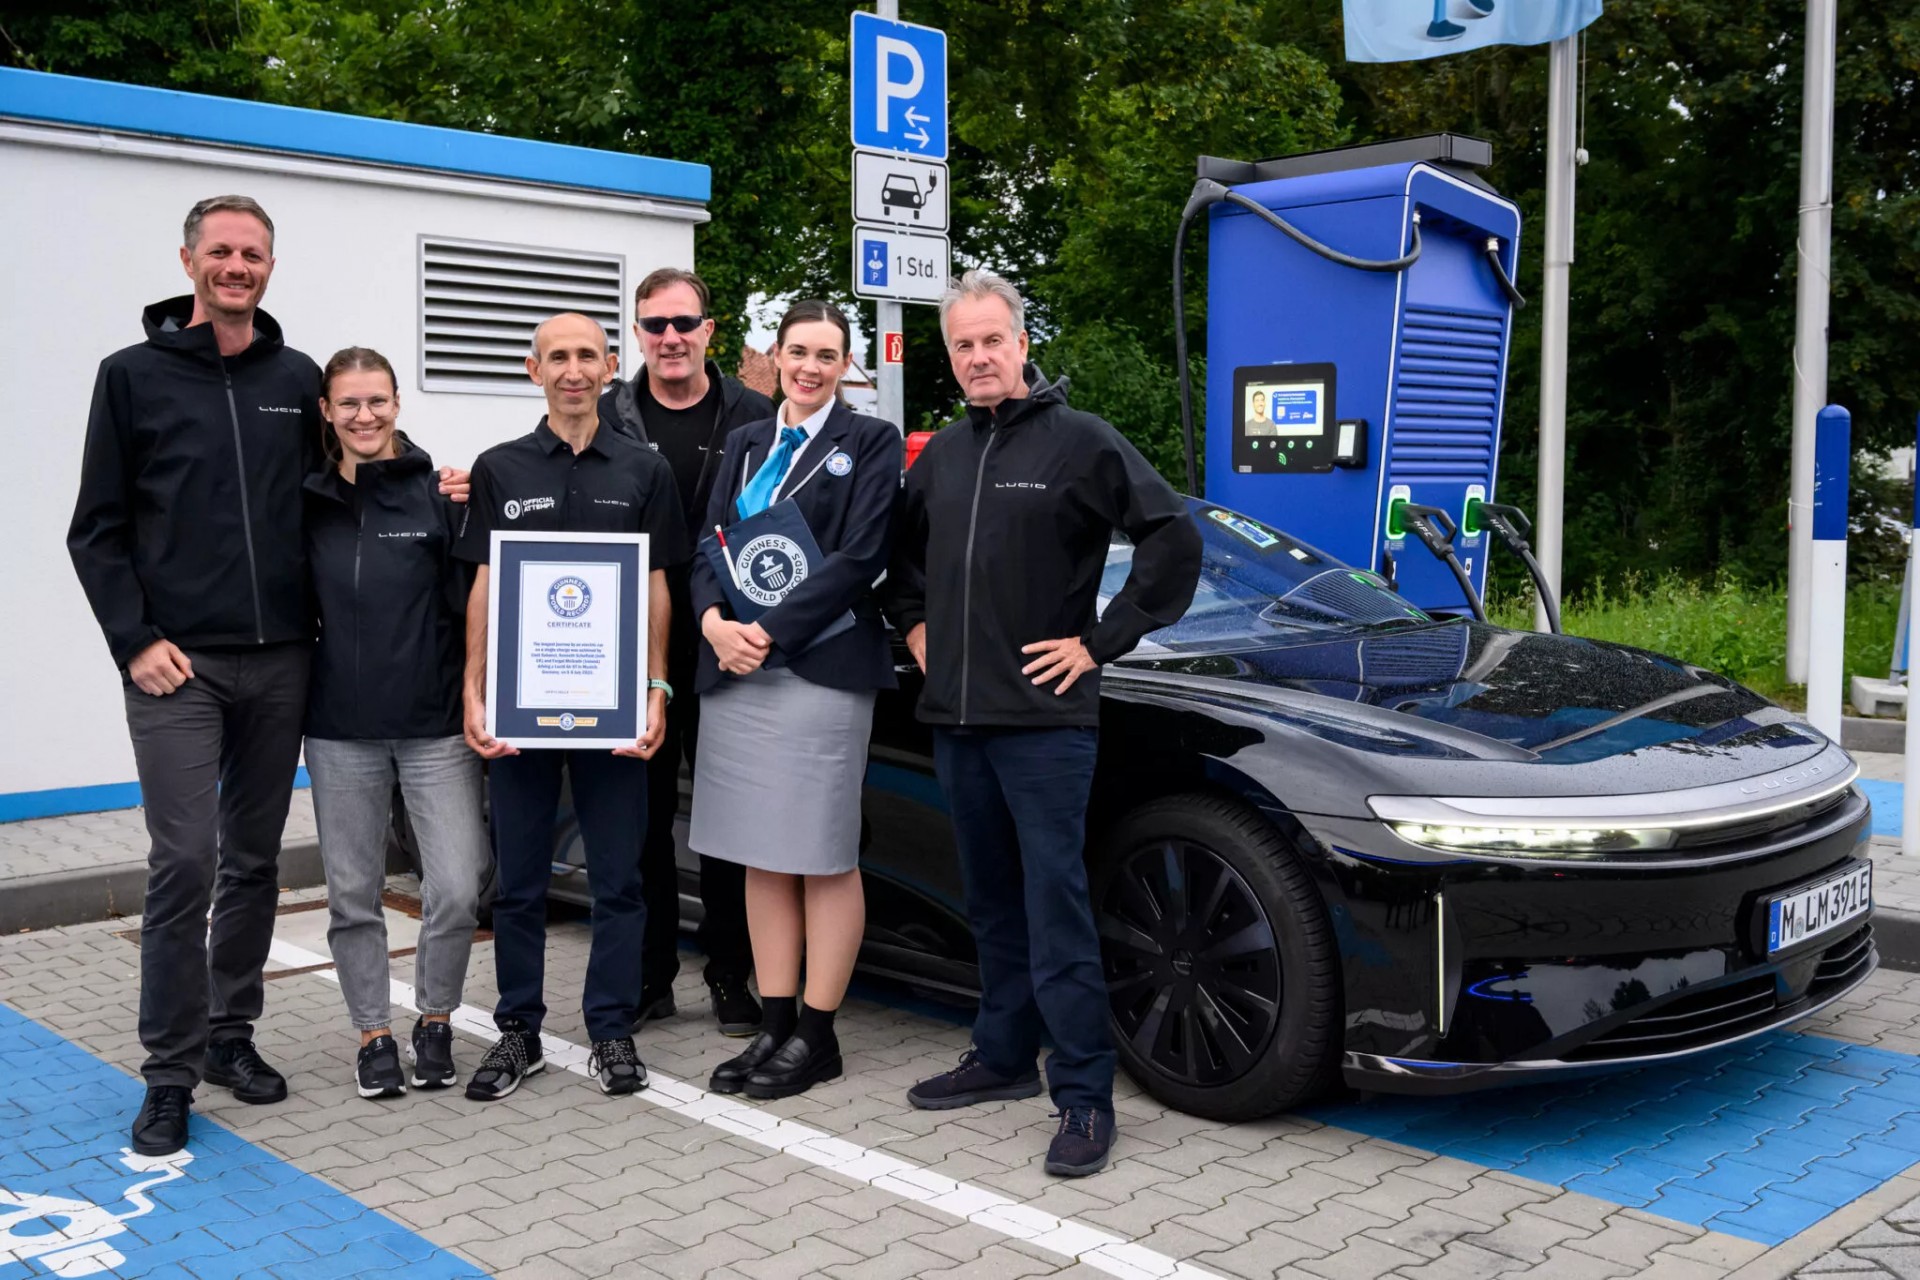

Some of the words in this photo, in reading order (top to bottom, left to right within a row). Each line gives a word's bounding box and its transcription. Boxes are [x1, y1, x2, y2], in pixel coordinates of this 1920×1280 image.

[876, 35, 925, 133] P
[897, 255, 902, 276] 1
[907, 256, 938, 279] Std.
[872, 272, 879, 282] P
[258, 406, 302, 414] LUCID
[994, 482, 1047, 490] LUCID
[522, 496, 555, 506] OFFICIAL
[523, 502, 555, 513] ATTEMPT
[741, 539, 788, 569] GUINNESS
[553, 578, 587, 590] GUINNESS
[743, 577, 777, 602] WORLD
[550, 594, 565, 616] WORLD
[566, 594, 590, 617] RECORDS
[546, 621, 592, 629] CERTIFICATE
[1739, 765, 1823, 795] LUCID
[1771, 931, 1777, 943] D
[1781, 901, 1796, 942] M
